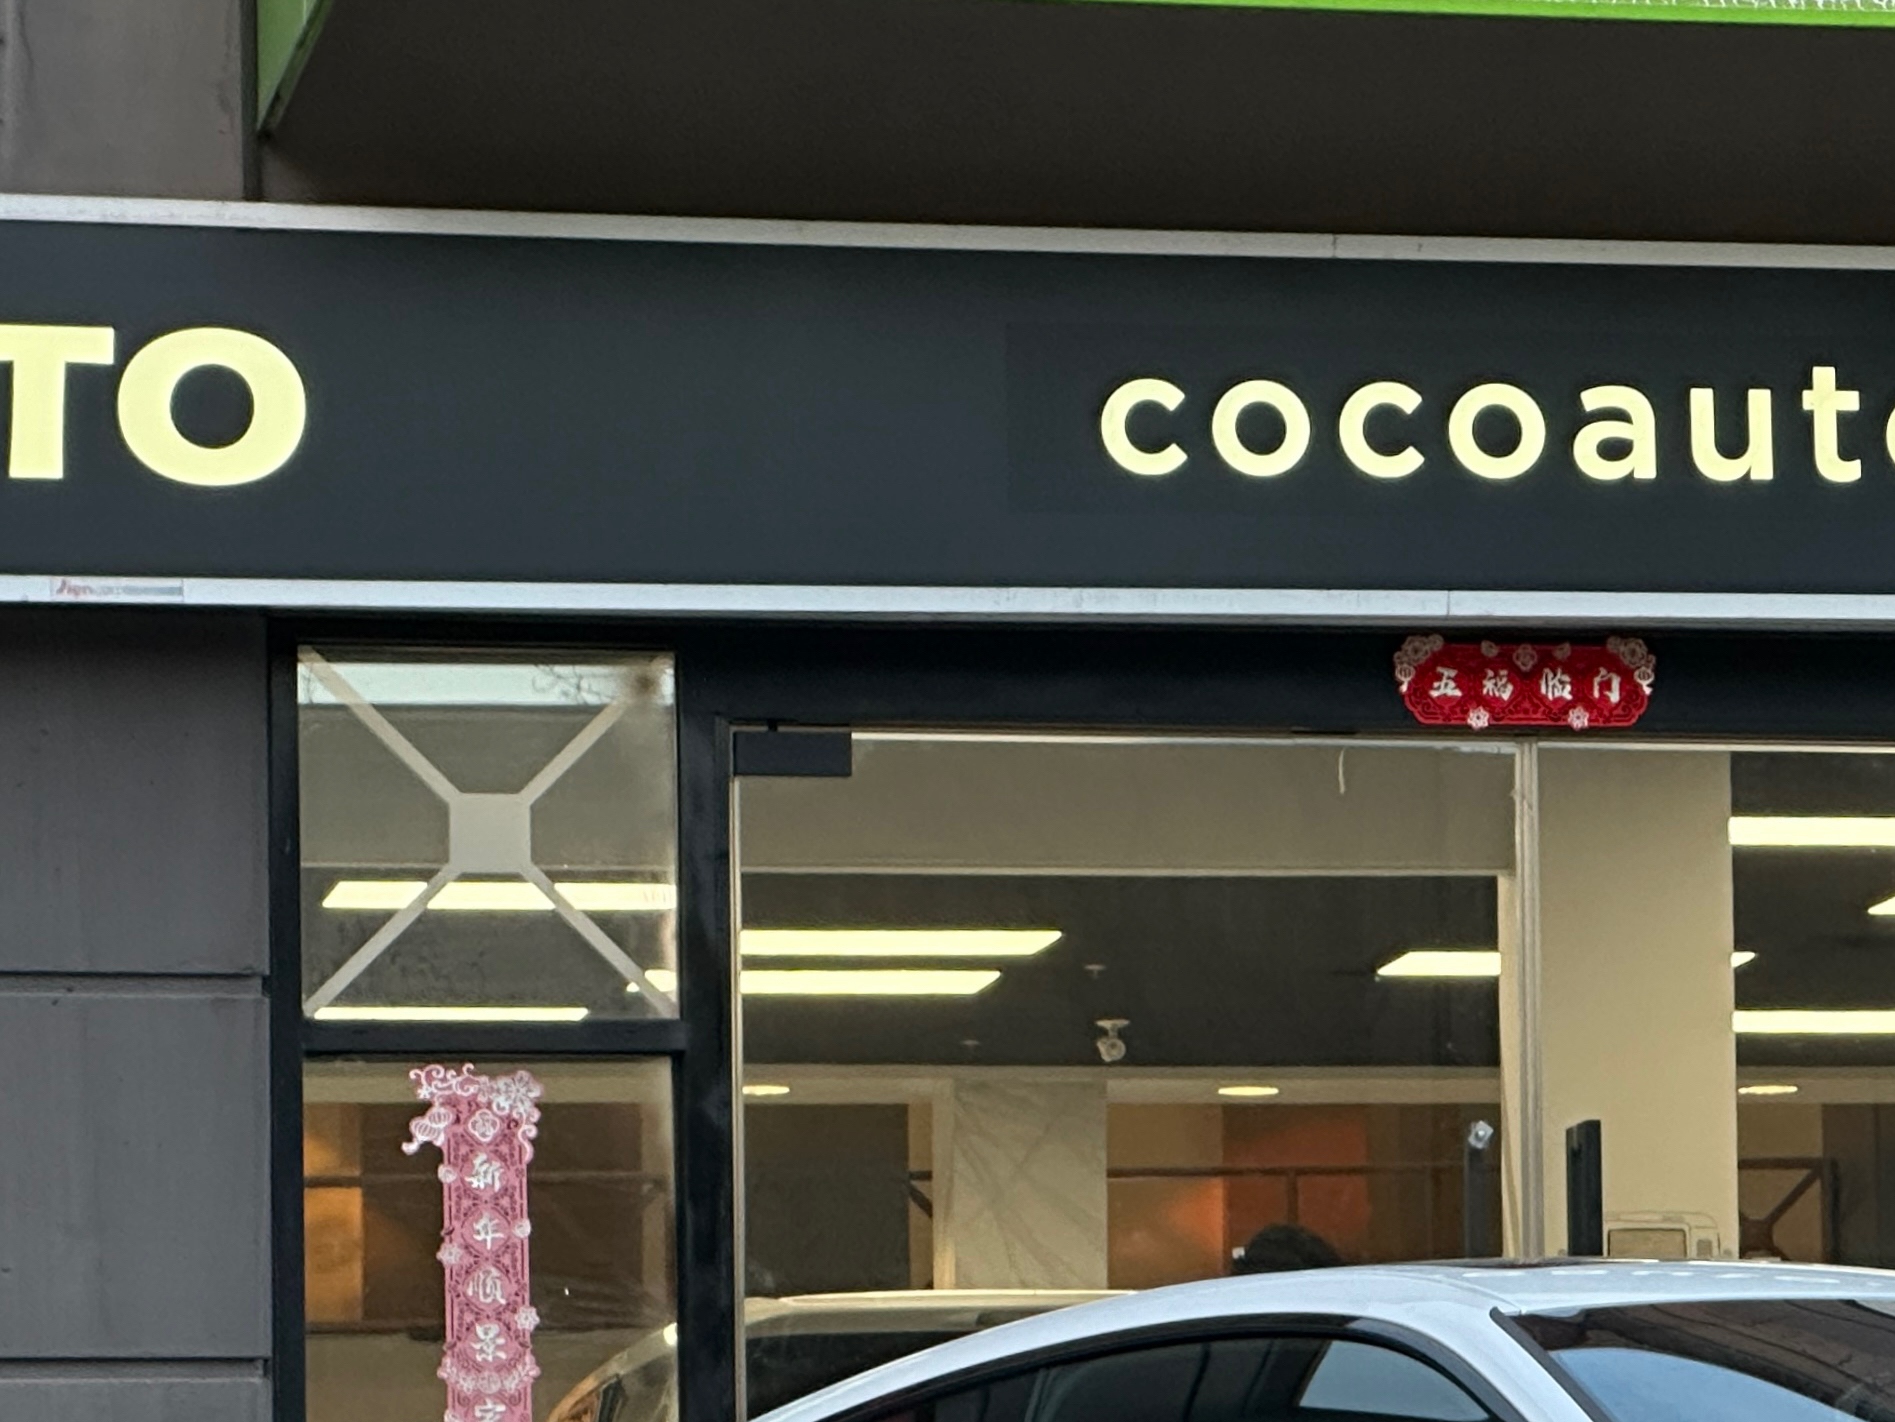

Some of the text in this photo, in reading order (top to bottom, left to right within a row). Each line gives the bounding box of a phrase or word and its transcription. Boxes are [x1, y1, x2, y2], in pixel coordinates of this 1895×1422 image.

[0, 324, 306, 486] TO
[1428, 666, 1622, 704] 五福临门
